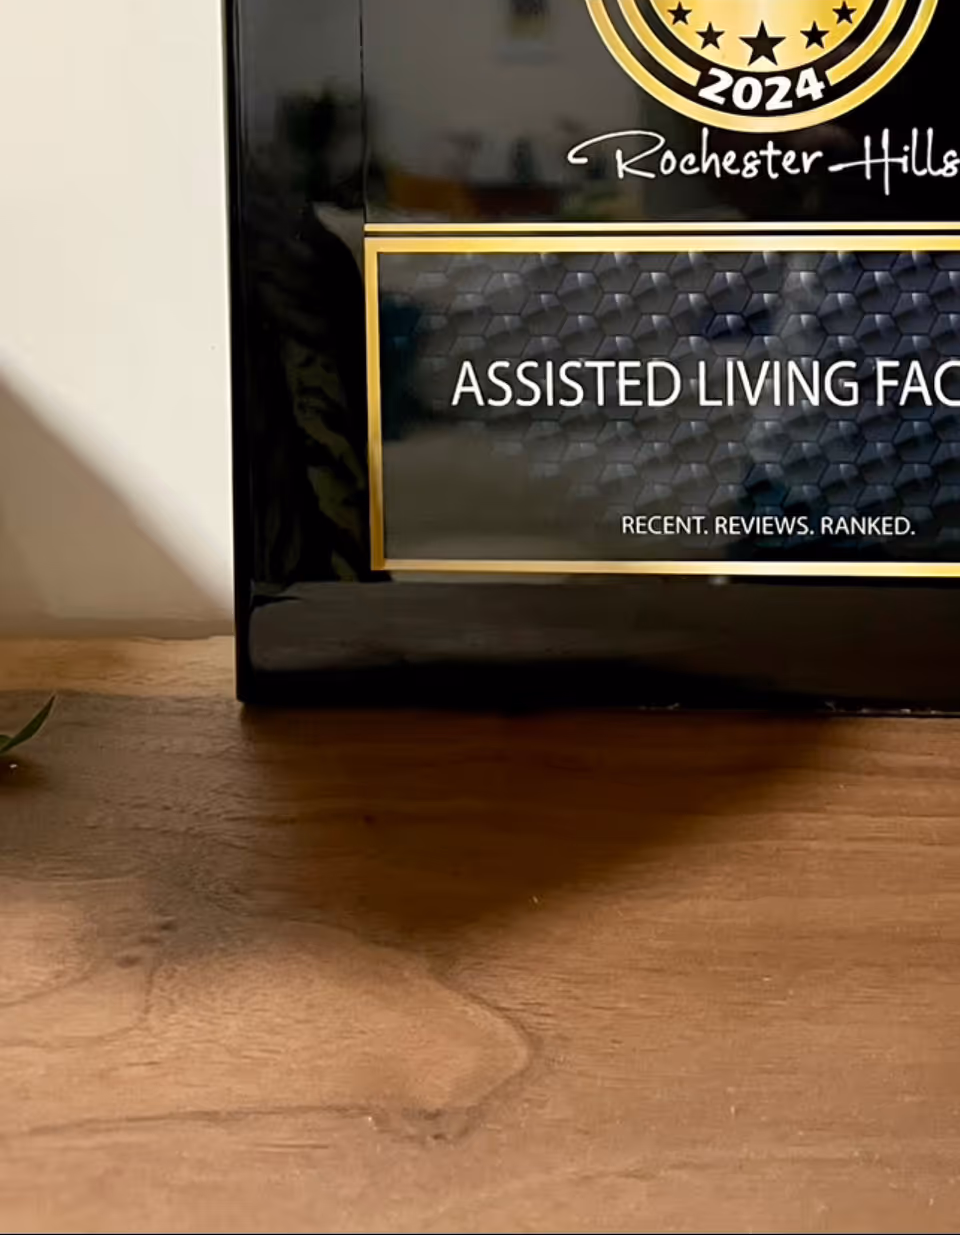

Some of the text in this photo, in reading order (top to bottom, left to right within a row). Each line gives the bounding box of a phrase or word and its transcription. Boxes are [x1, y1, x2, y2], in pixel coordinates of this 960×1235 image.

[698, 67, 826, 111] 2024
[567, 127, 823, 179] Rochester
[451, 360, 681, 407] ASSISTED
[698, 358, 860, 407] LIVING
[622, 515, 916, 536] RECENT. REVIEWS. RANKED.
